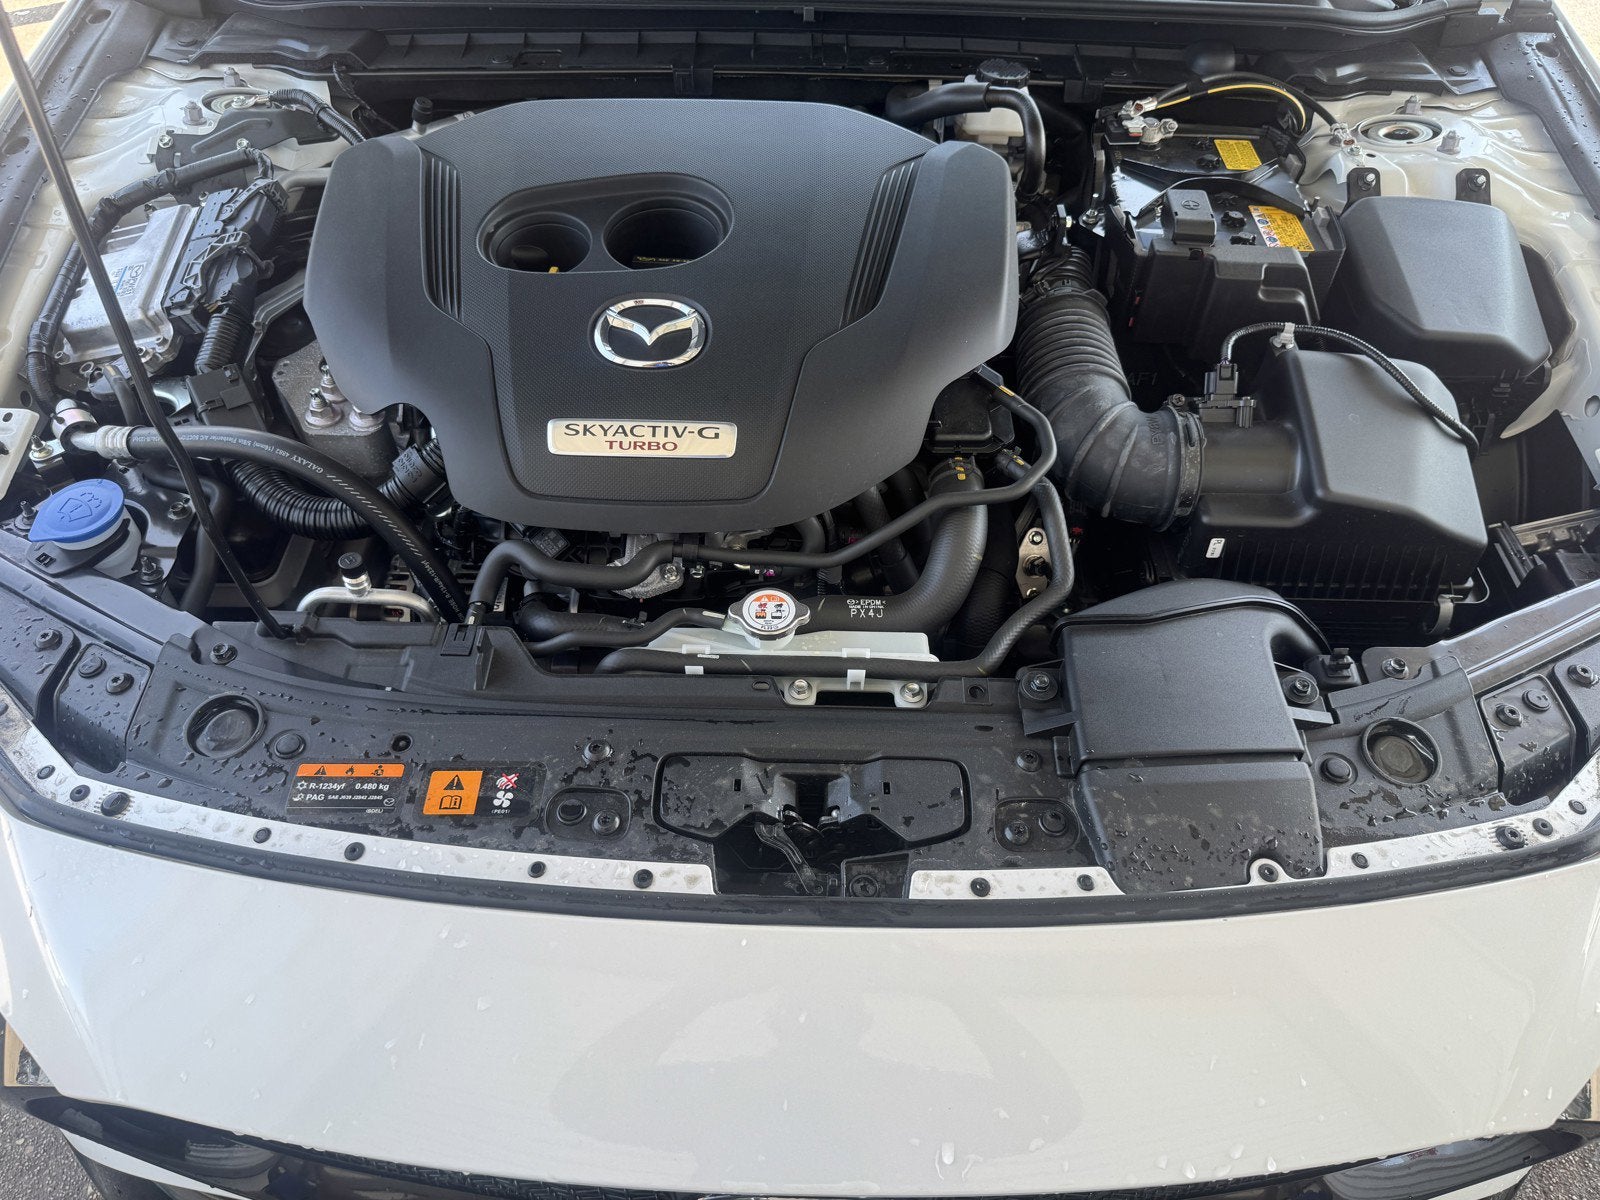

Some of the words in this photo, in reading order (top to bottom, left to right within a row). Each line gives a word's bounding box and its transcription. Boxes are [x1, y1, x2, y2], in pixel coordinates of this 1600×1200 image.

[564, 423, 720, 440] SKYACTIV-G
[605, 440, 678, 451] TURBO
[290, 455, 324, 474] GALAXY
[850, 608, 884, 618] PX4J
[309, 782, 346, 791] R-1234yf
[355, 782, 378, 790] 0.480
[378, 782, 390, 791] kg
[305, 793, 325, 801] PAG
